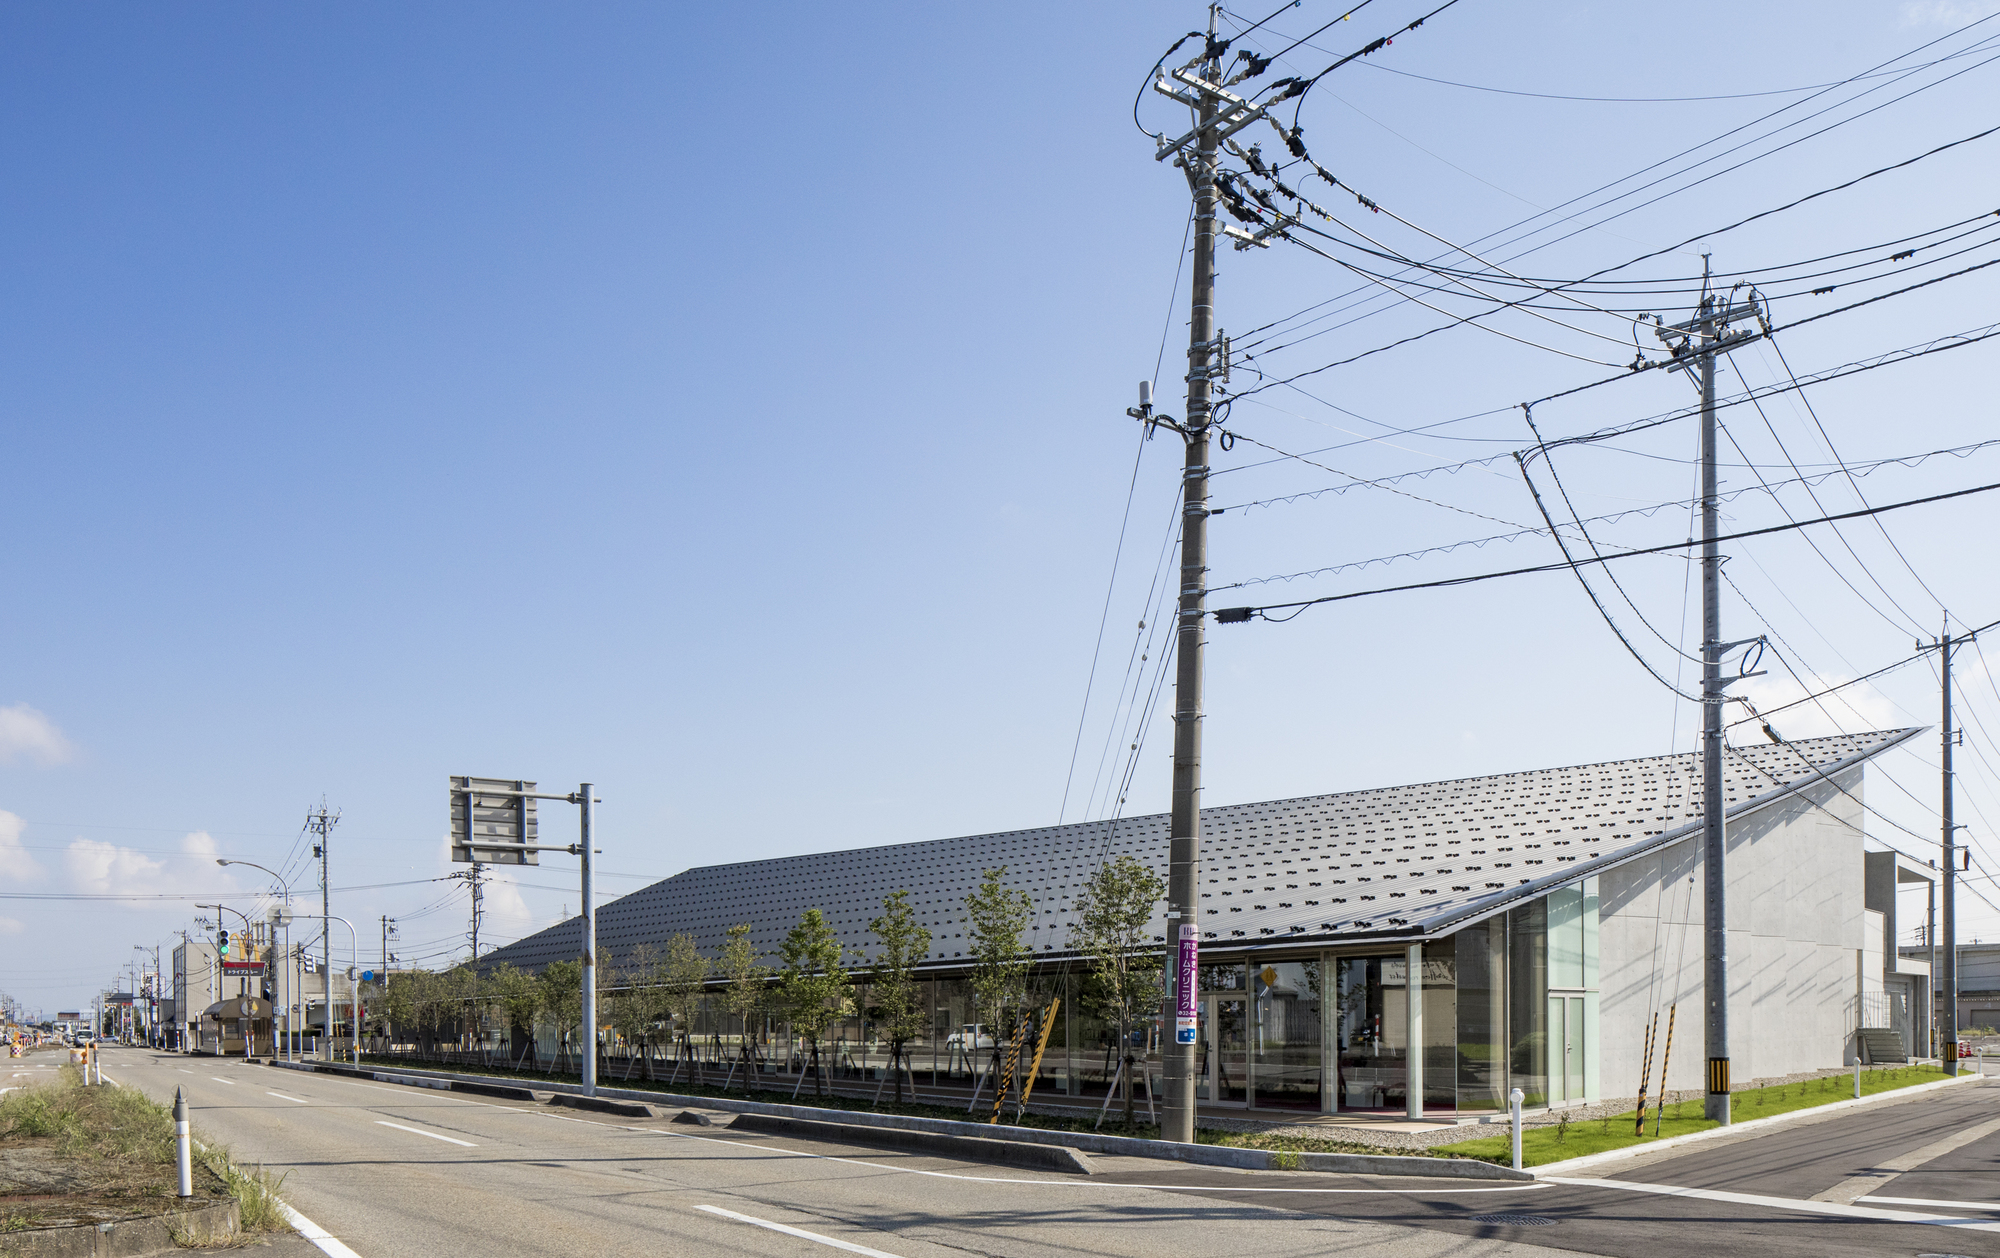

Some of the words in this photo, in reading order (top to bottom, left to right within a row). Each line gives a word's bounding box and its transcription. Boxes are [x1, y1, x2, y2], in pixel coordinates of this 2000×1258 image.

[1182, 942, 1191, 1009] ホームクリニック
